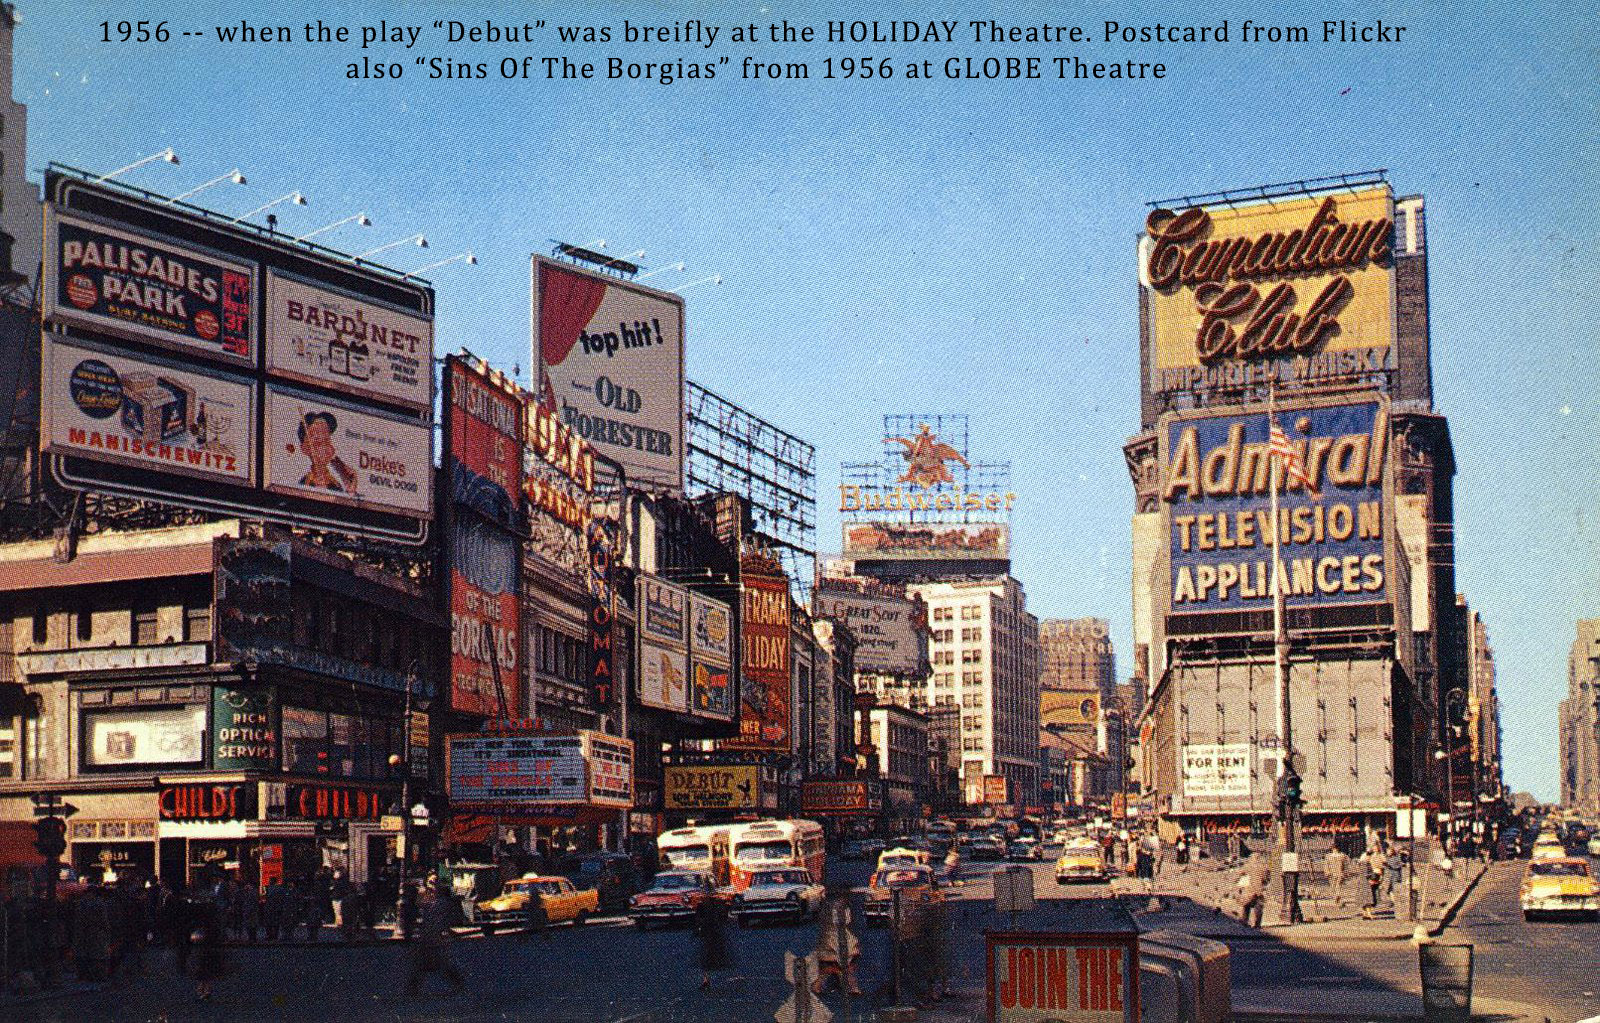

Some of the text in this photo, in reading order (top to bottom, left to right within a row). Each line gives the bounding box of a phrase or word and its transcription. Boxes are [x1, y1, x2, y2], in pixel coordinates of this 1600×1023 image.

[1147, 196, 1394, 289] Canadian
[64, 240, 218, 303] PALISADES
[103, 274, 187, 318] PARK
[287, 300, 420, 353] BARDINET
[579, 318, 664, 358] top hit!
[1196, 276, 1353, 365] Club
[595, 375, 642, 414] OLD
[69, 427, 237, 471] MANISCHEWITZ
[562, 398, 672, 456] FORESTER
[1164, 402, 1388, 500] Admiral
[838, 485, 1017, 511] Budweiser
[1175, 501, 1382, 552] TELEVISION
[1174, 553, 1384, 603] APPLIANCES
[232, 712, 267, 724] RICH
[218, 745, 275, 759] SERVICE
[1187, 757, 1246, 768] FOR RENT
[159, 787, 239, 818] CHILDS
[1000, 947, 1124, 1011] JOIN THE
